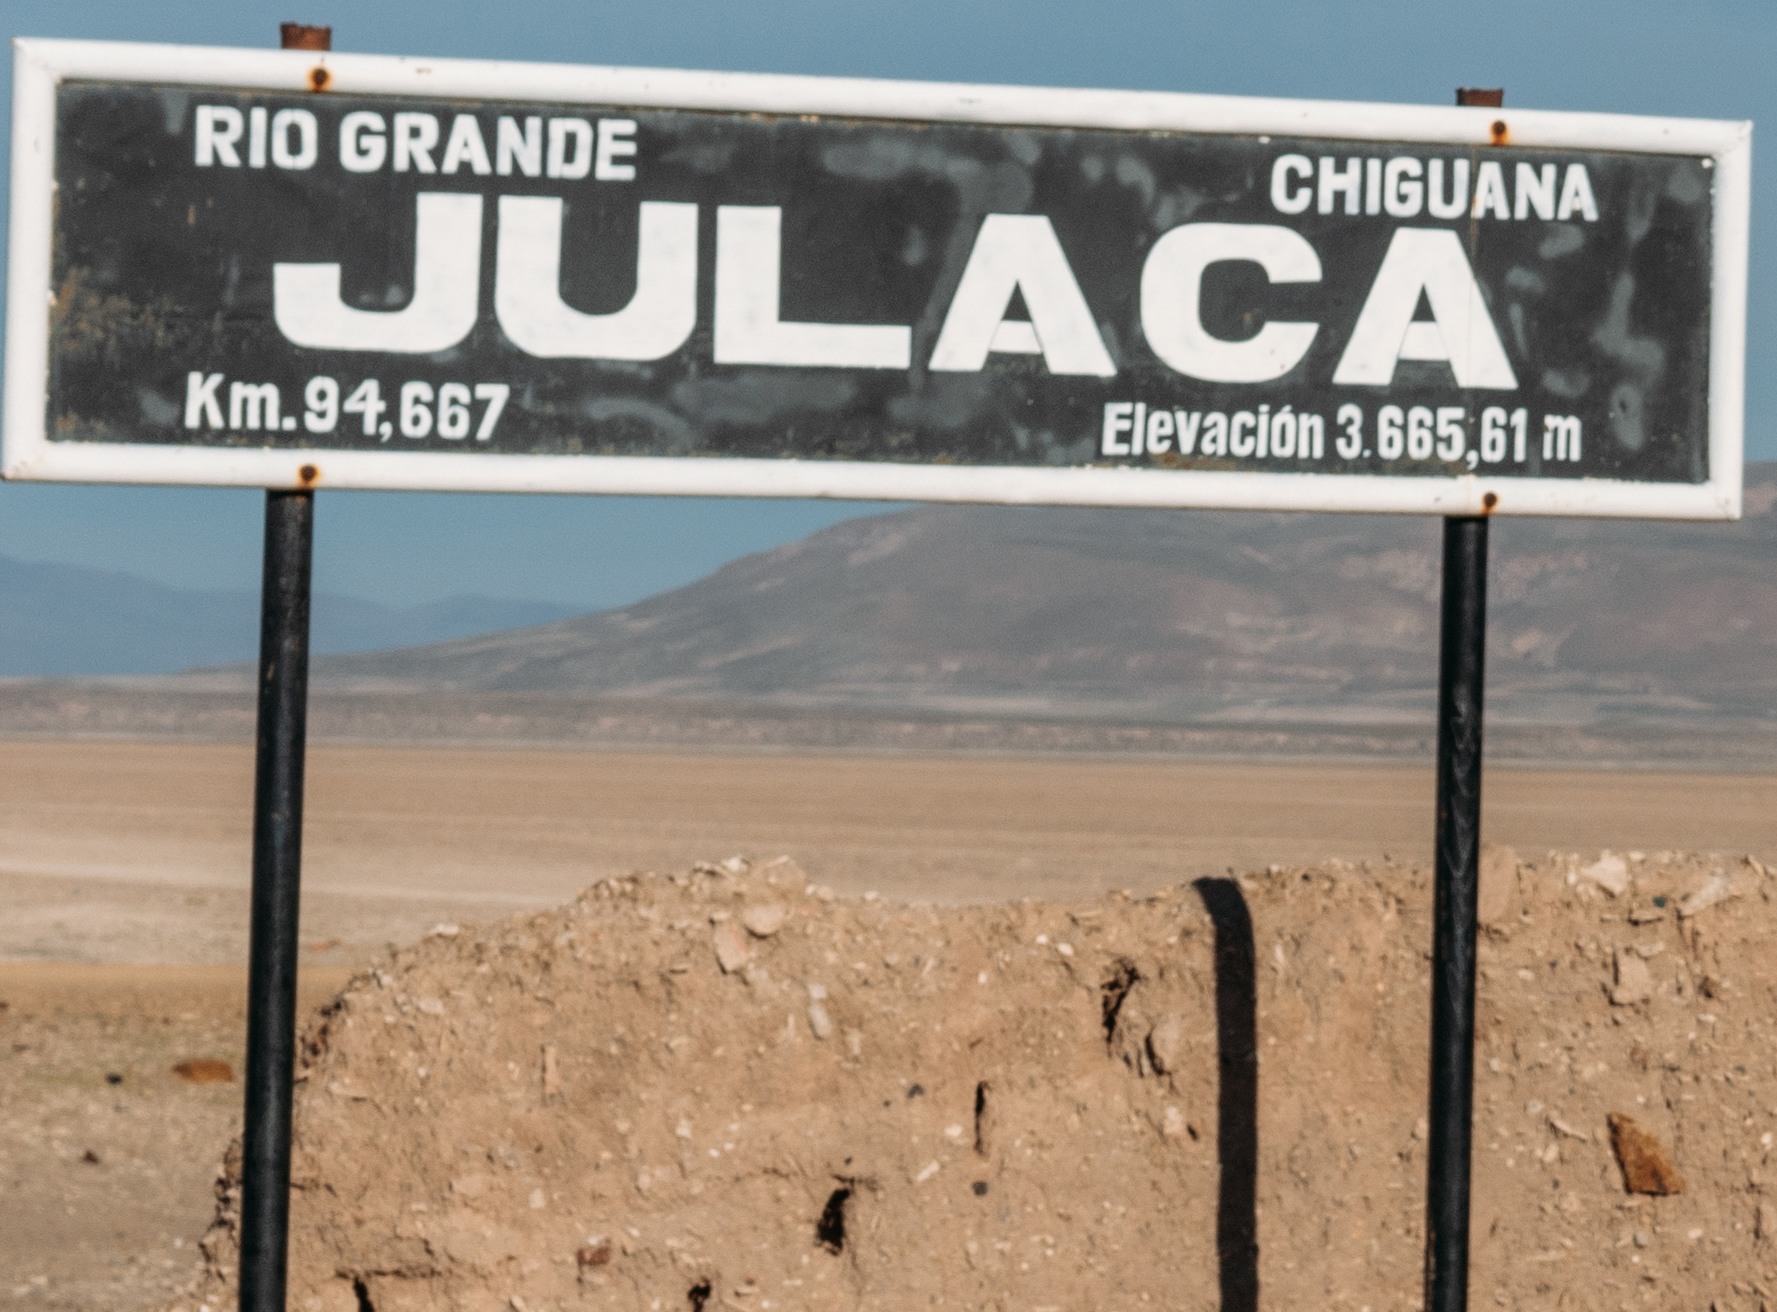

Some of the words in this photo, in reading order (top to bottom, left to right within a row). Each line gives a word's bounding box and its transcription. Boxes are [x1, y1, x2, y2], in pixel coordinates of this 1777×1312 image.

[195, 105, 318, 170] RIO
[339, 111, 637, 181] GRANDE
[1270, 153, 1599, 222] CHIGUANA
[273, 192, 1518, 390] JULACA
[1101, 402, 1324, 460] Elevación
[1335, 403, 1528, 470] 3.665,61
[1542, 413, 1582, 462] m
